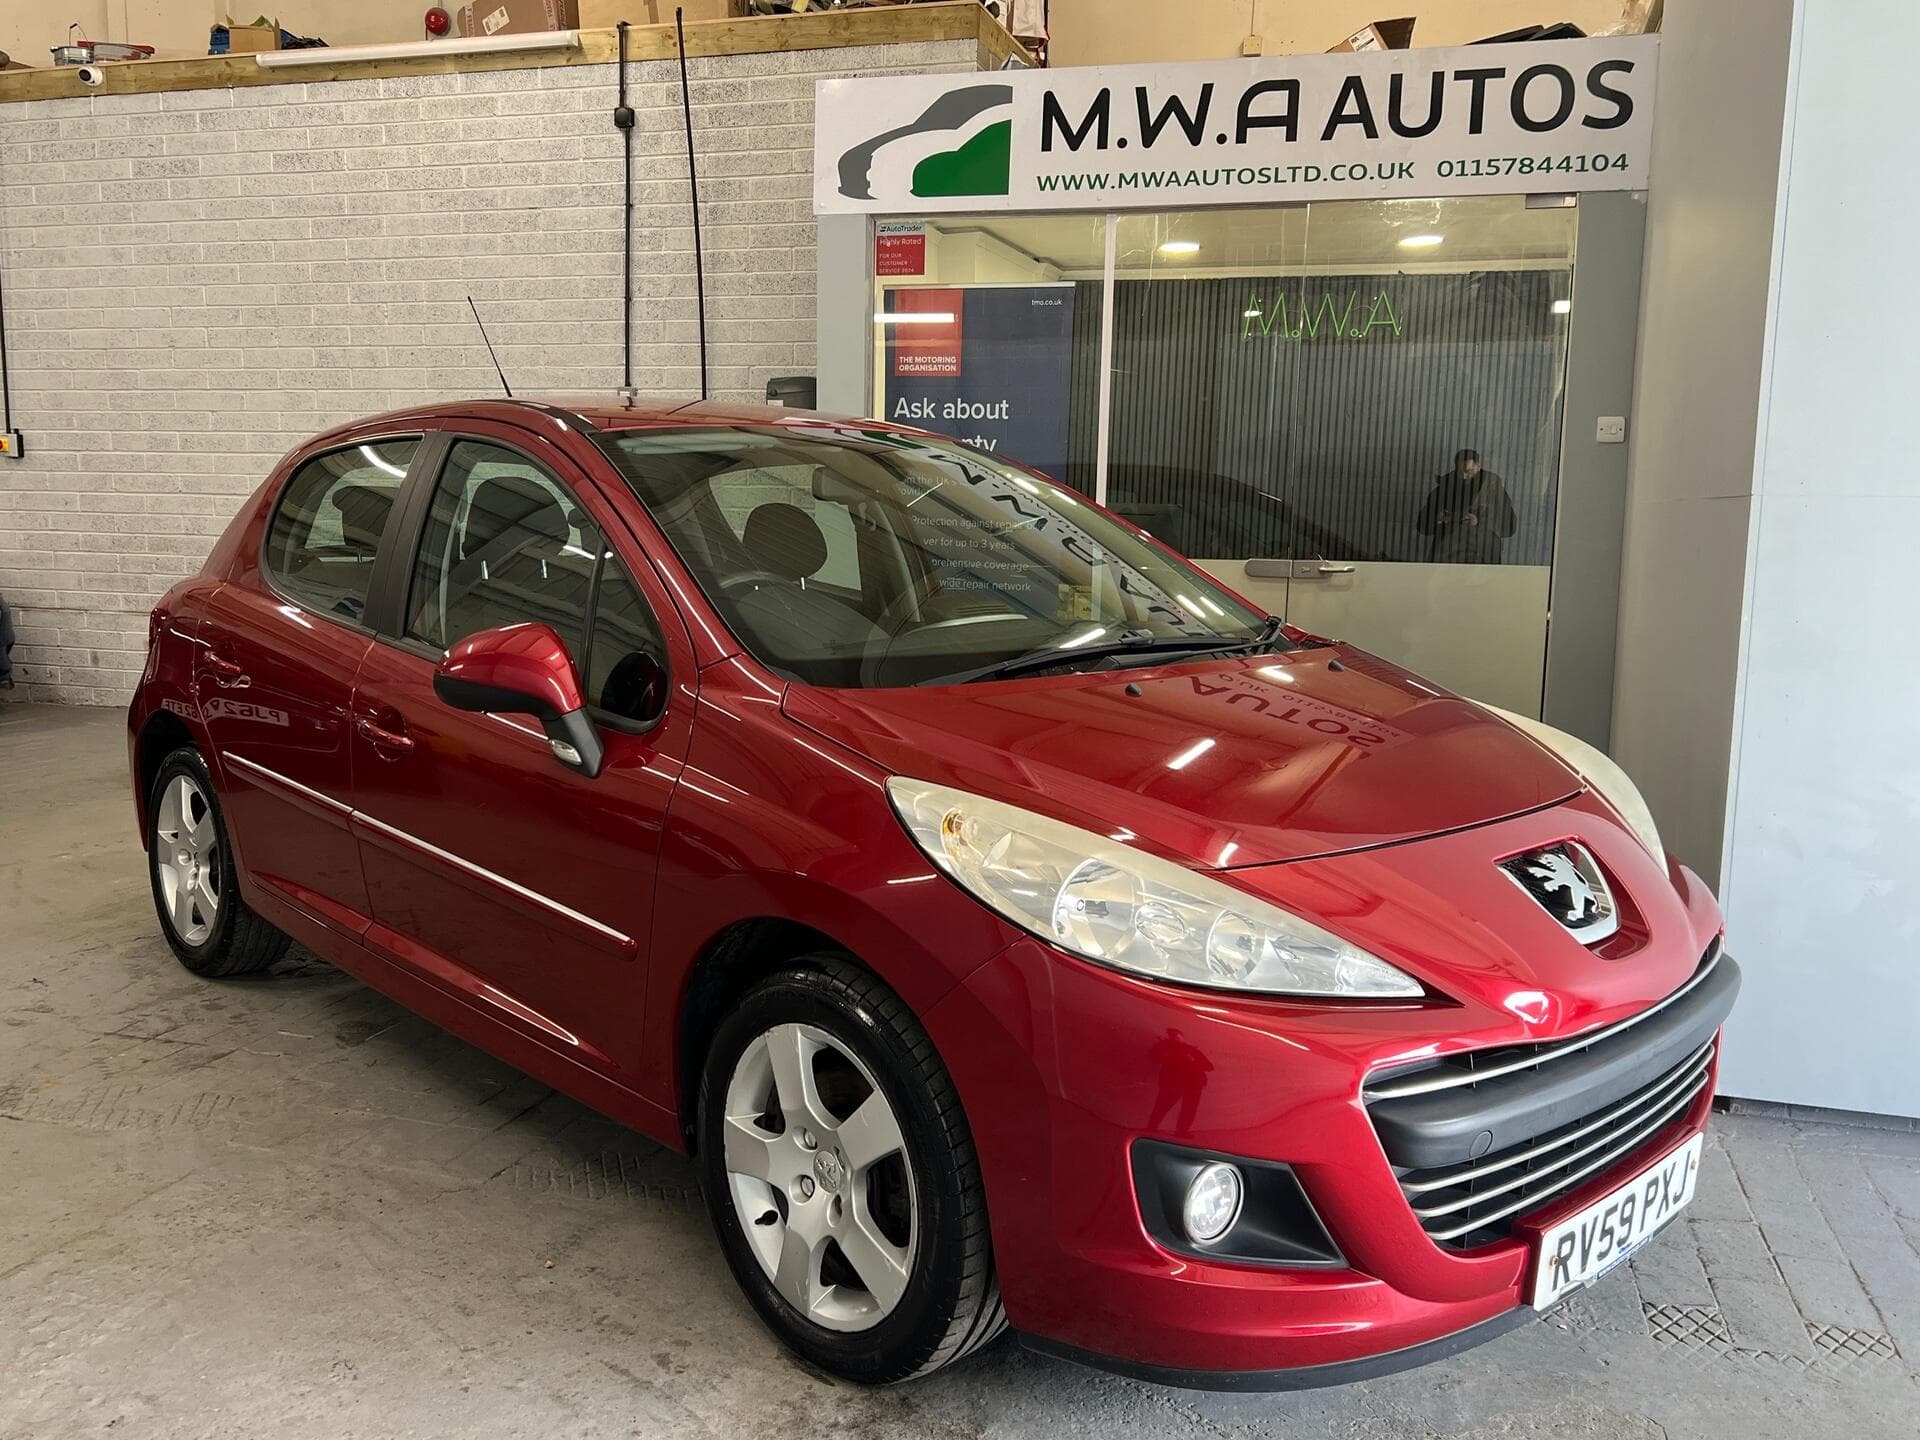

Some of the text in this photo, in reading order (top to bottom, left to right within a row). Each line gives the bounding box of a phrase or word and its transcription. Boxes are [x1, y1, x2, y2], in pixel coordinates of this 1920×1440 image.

[1041, 60, 1634, 152] M.W.A AUTOS
[1037, 153, 1629, 192] WWW.MWAAUTOSLTD.CO.UK 01157844104
[885, 225, 922, 233] AutoTrader
[1031, 298, 1063, 306] tmo.co.uk
[899, 356, 957, 364] THE MOTORING
[898, 364, 957, 372] ORGANISATION
[894, 397, 1009, 420] Ask about
[912, 515, 957, 527] Protection
[961, 518, 993, 530] against
[940, 537, 952, 547] for
[984, 560, 1029, 572] coverage
[963, 580, 991, 592] repair
[992, 581, 1032, 592] network
[1552, 1194, 1636, 1292] RV59
[1639, 1150, 1692, 1233] PXJ
